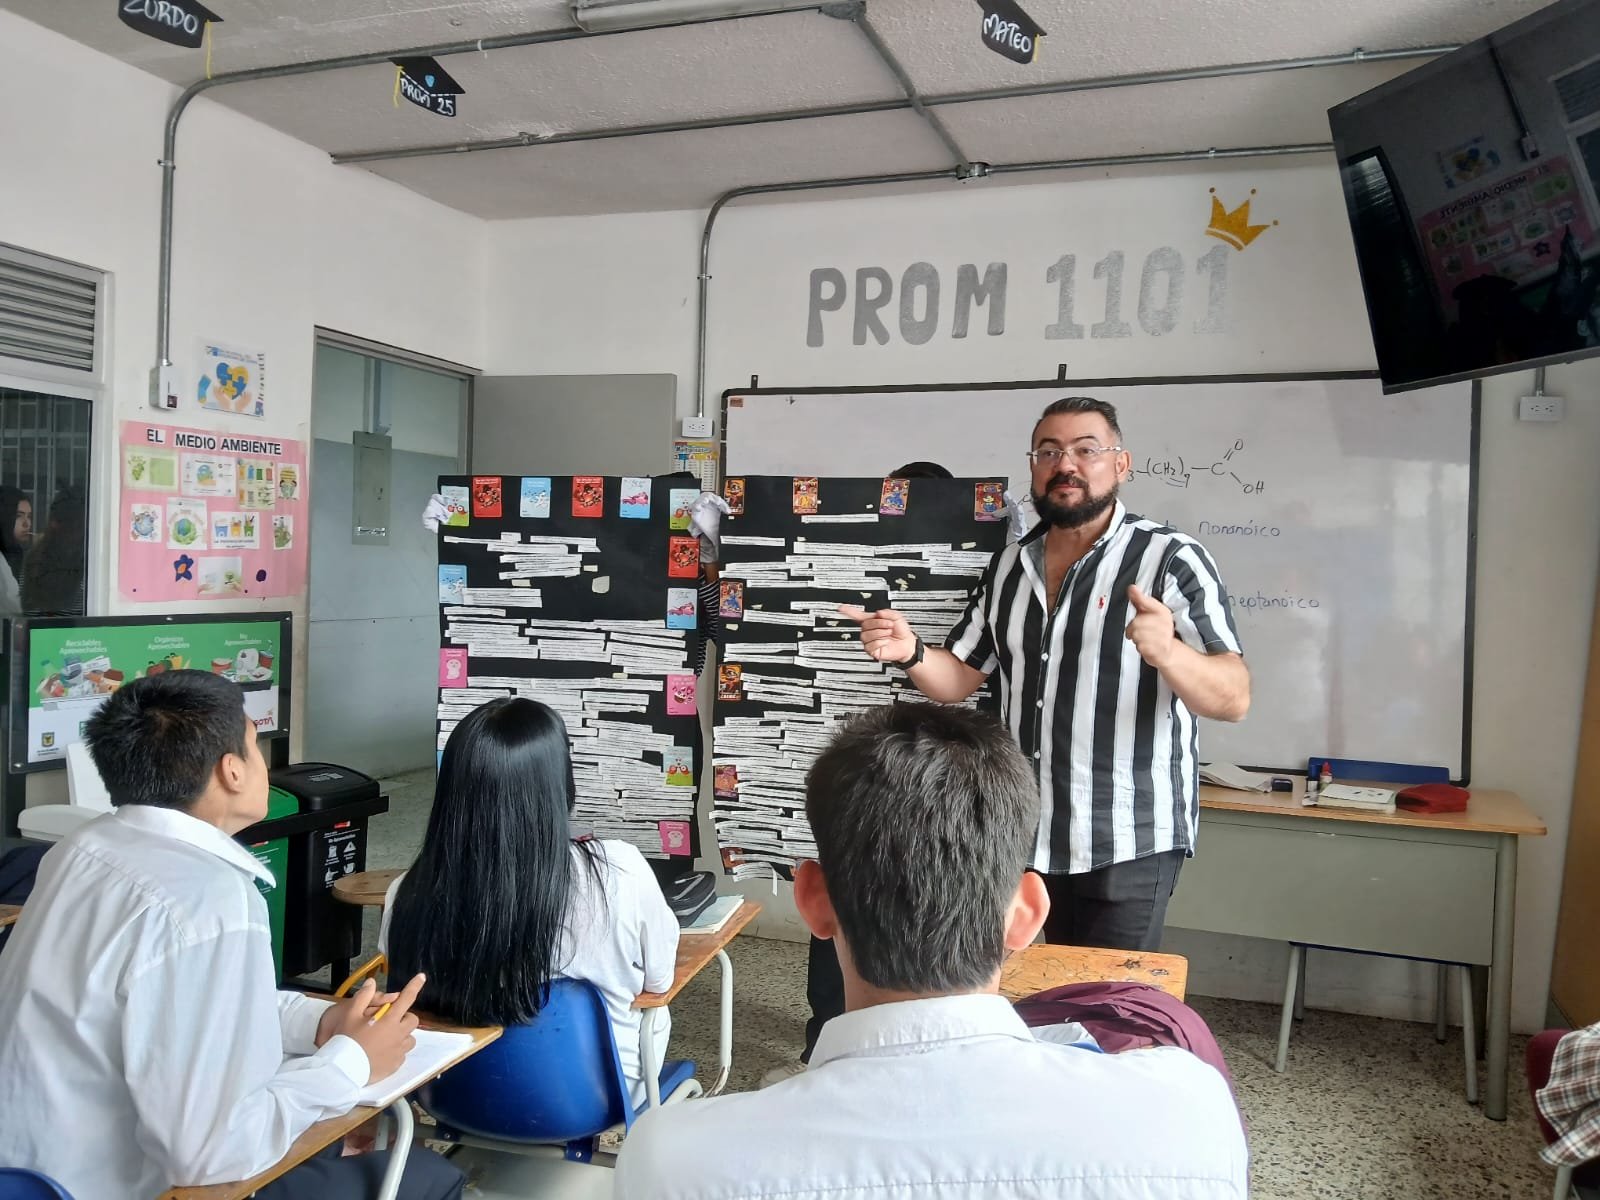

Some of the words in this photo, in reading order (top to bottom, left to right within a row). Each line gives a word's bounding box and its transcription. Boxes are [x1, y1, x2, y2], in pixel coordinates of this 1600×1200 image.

[983, 13, 1032, 53] MATEO
[400, 77, 431, 107] PROM
[436, 97, 454, 115] 25
[806, 261, 1007, 347] PROM
[1045, 245, 1232, 340] 1101
[147, 428, 164, 443] EL
[175, 433, 216, 450] MEDIO
[221, 438, 282, 455] AMBIENTE
